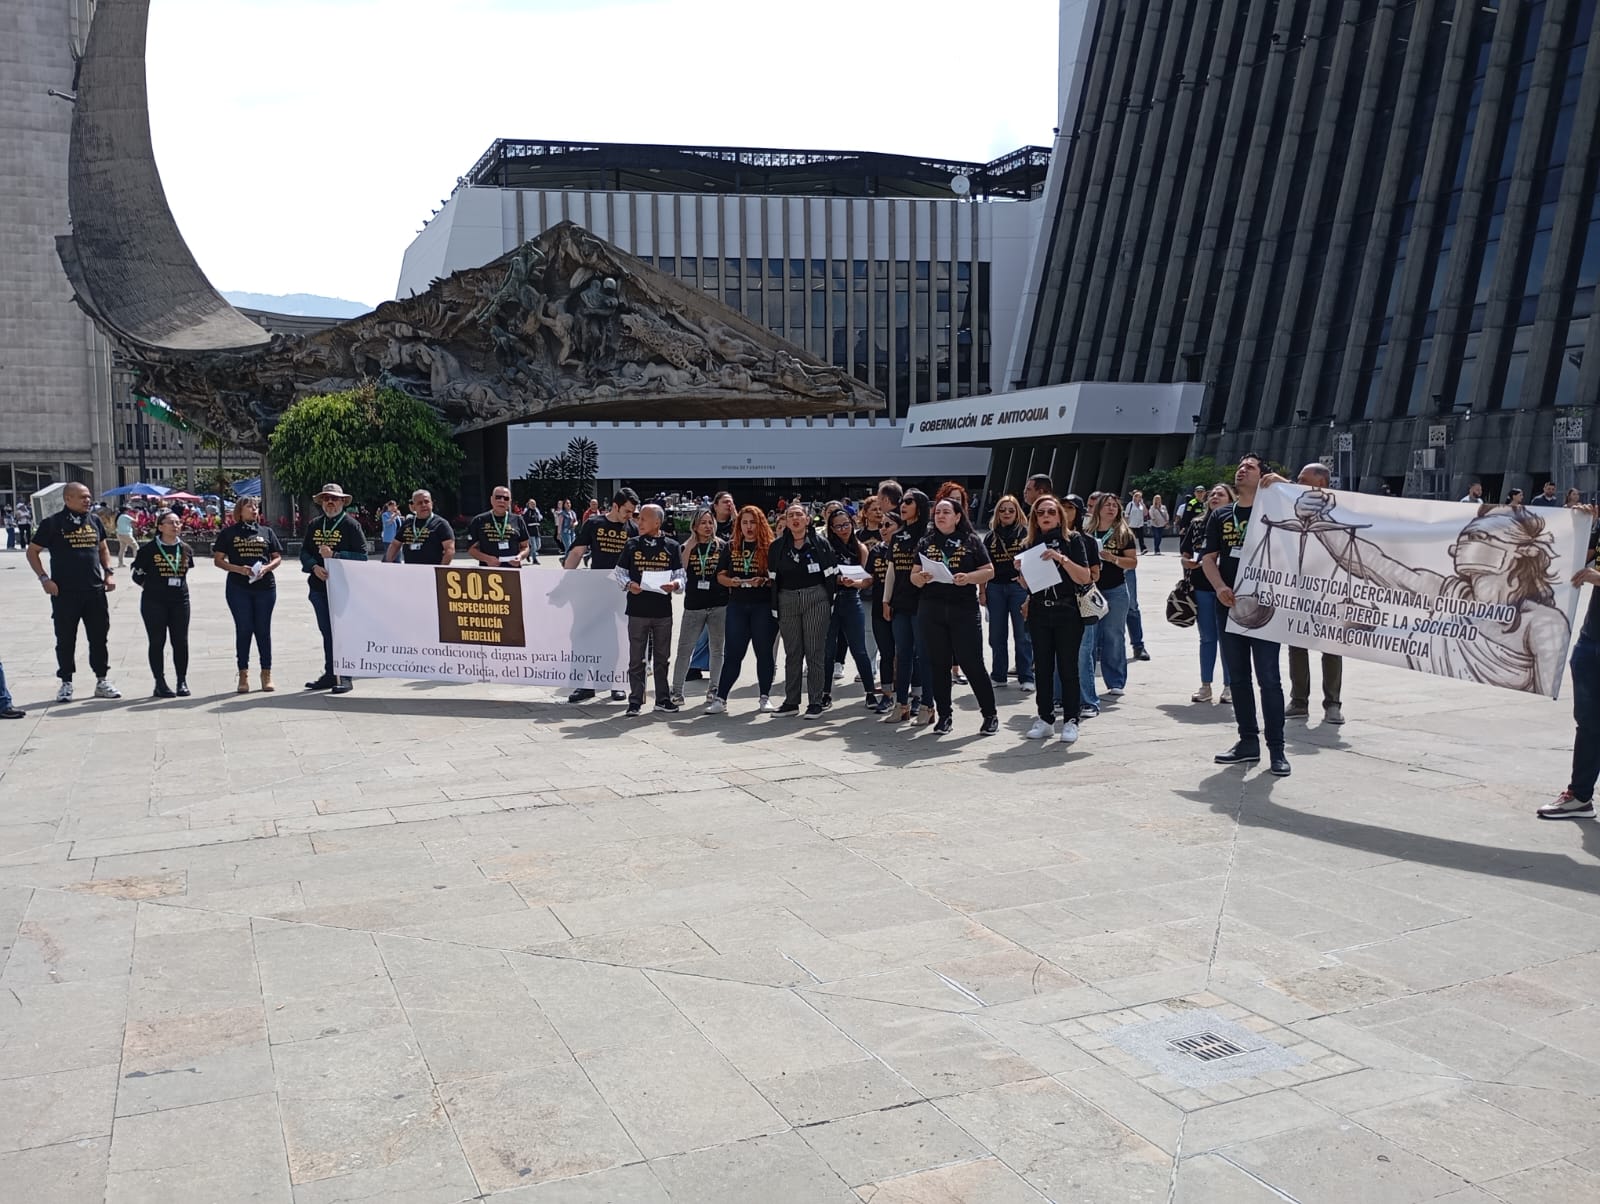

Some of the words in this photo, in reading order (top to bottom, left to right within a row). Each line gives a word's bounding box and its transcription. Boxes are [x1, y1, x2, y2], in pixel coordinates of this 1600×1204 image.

[920, 412, 977, 432] GOBERNACIÓN
[980, 413, 994, 426] DE
[998, 407, 1049, 425] ANTIOQUIA
[446, 571, 510, 601] S.O.S.
[1243, 566, 1282, 585] CUANDO
[1284, 573, 1297, 589] LA
[1300, 576, 1348, 597] JUSTICIA
[1352, 584, 1409, 607] CERCANA
[1413, 594, 1430, 611] AL
[1435, 597, 1515, 622] CIUDADANO
[448, 601, 510, 615] INSPECCIONES
[1259, 591, 1272, 605] ES
[1274, 593, 1340, 620] SILENCIADA,
[1345, 606, 1389, 627] PIERDE
[1393, 614, 1408, 630] LA
[1412, 618, 1478, 641] SOCIEDAD
[457, 615, 469, 627] DE
[469, 616, 503, 629] POLICÍA
[461, 630, 500, 642] MEDELLÍN
[1287, 618, 1295, 632] Y
[1297, 620, 1310, 636] LA
[1313, 623, 1344, 642] SANA
[1347, 629, 1429, 658] CONVIVENCIA
[367, 641, 388, 653] Por
[391, 645, 418, 655] unas
[421, 645, 487, 659] condiciones
[491, 648, 527, 662] dignas
[531, 653, 557, 664] para
[561, 650, 602, 664] laborar
[342, 656, 356, 669] las
[439, 662, 453, 675] de
[502, 666, 519, 678] del
[524, 666, 566, 681] Distrito
[569, 669, 584, 681] de
[587, 669, 629, 683] Medell
